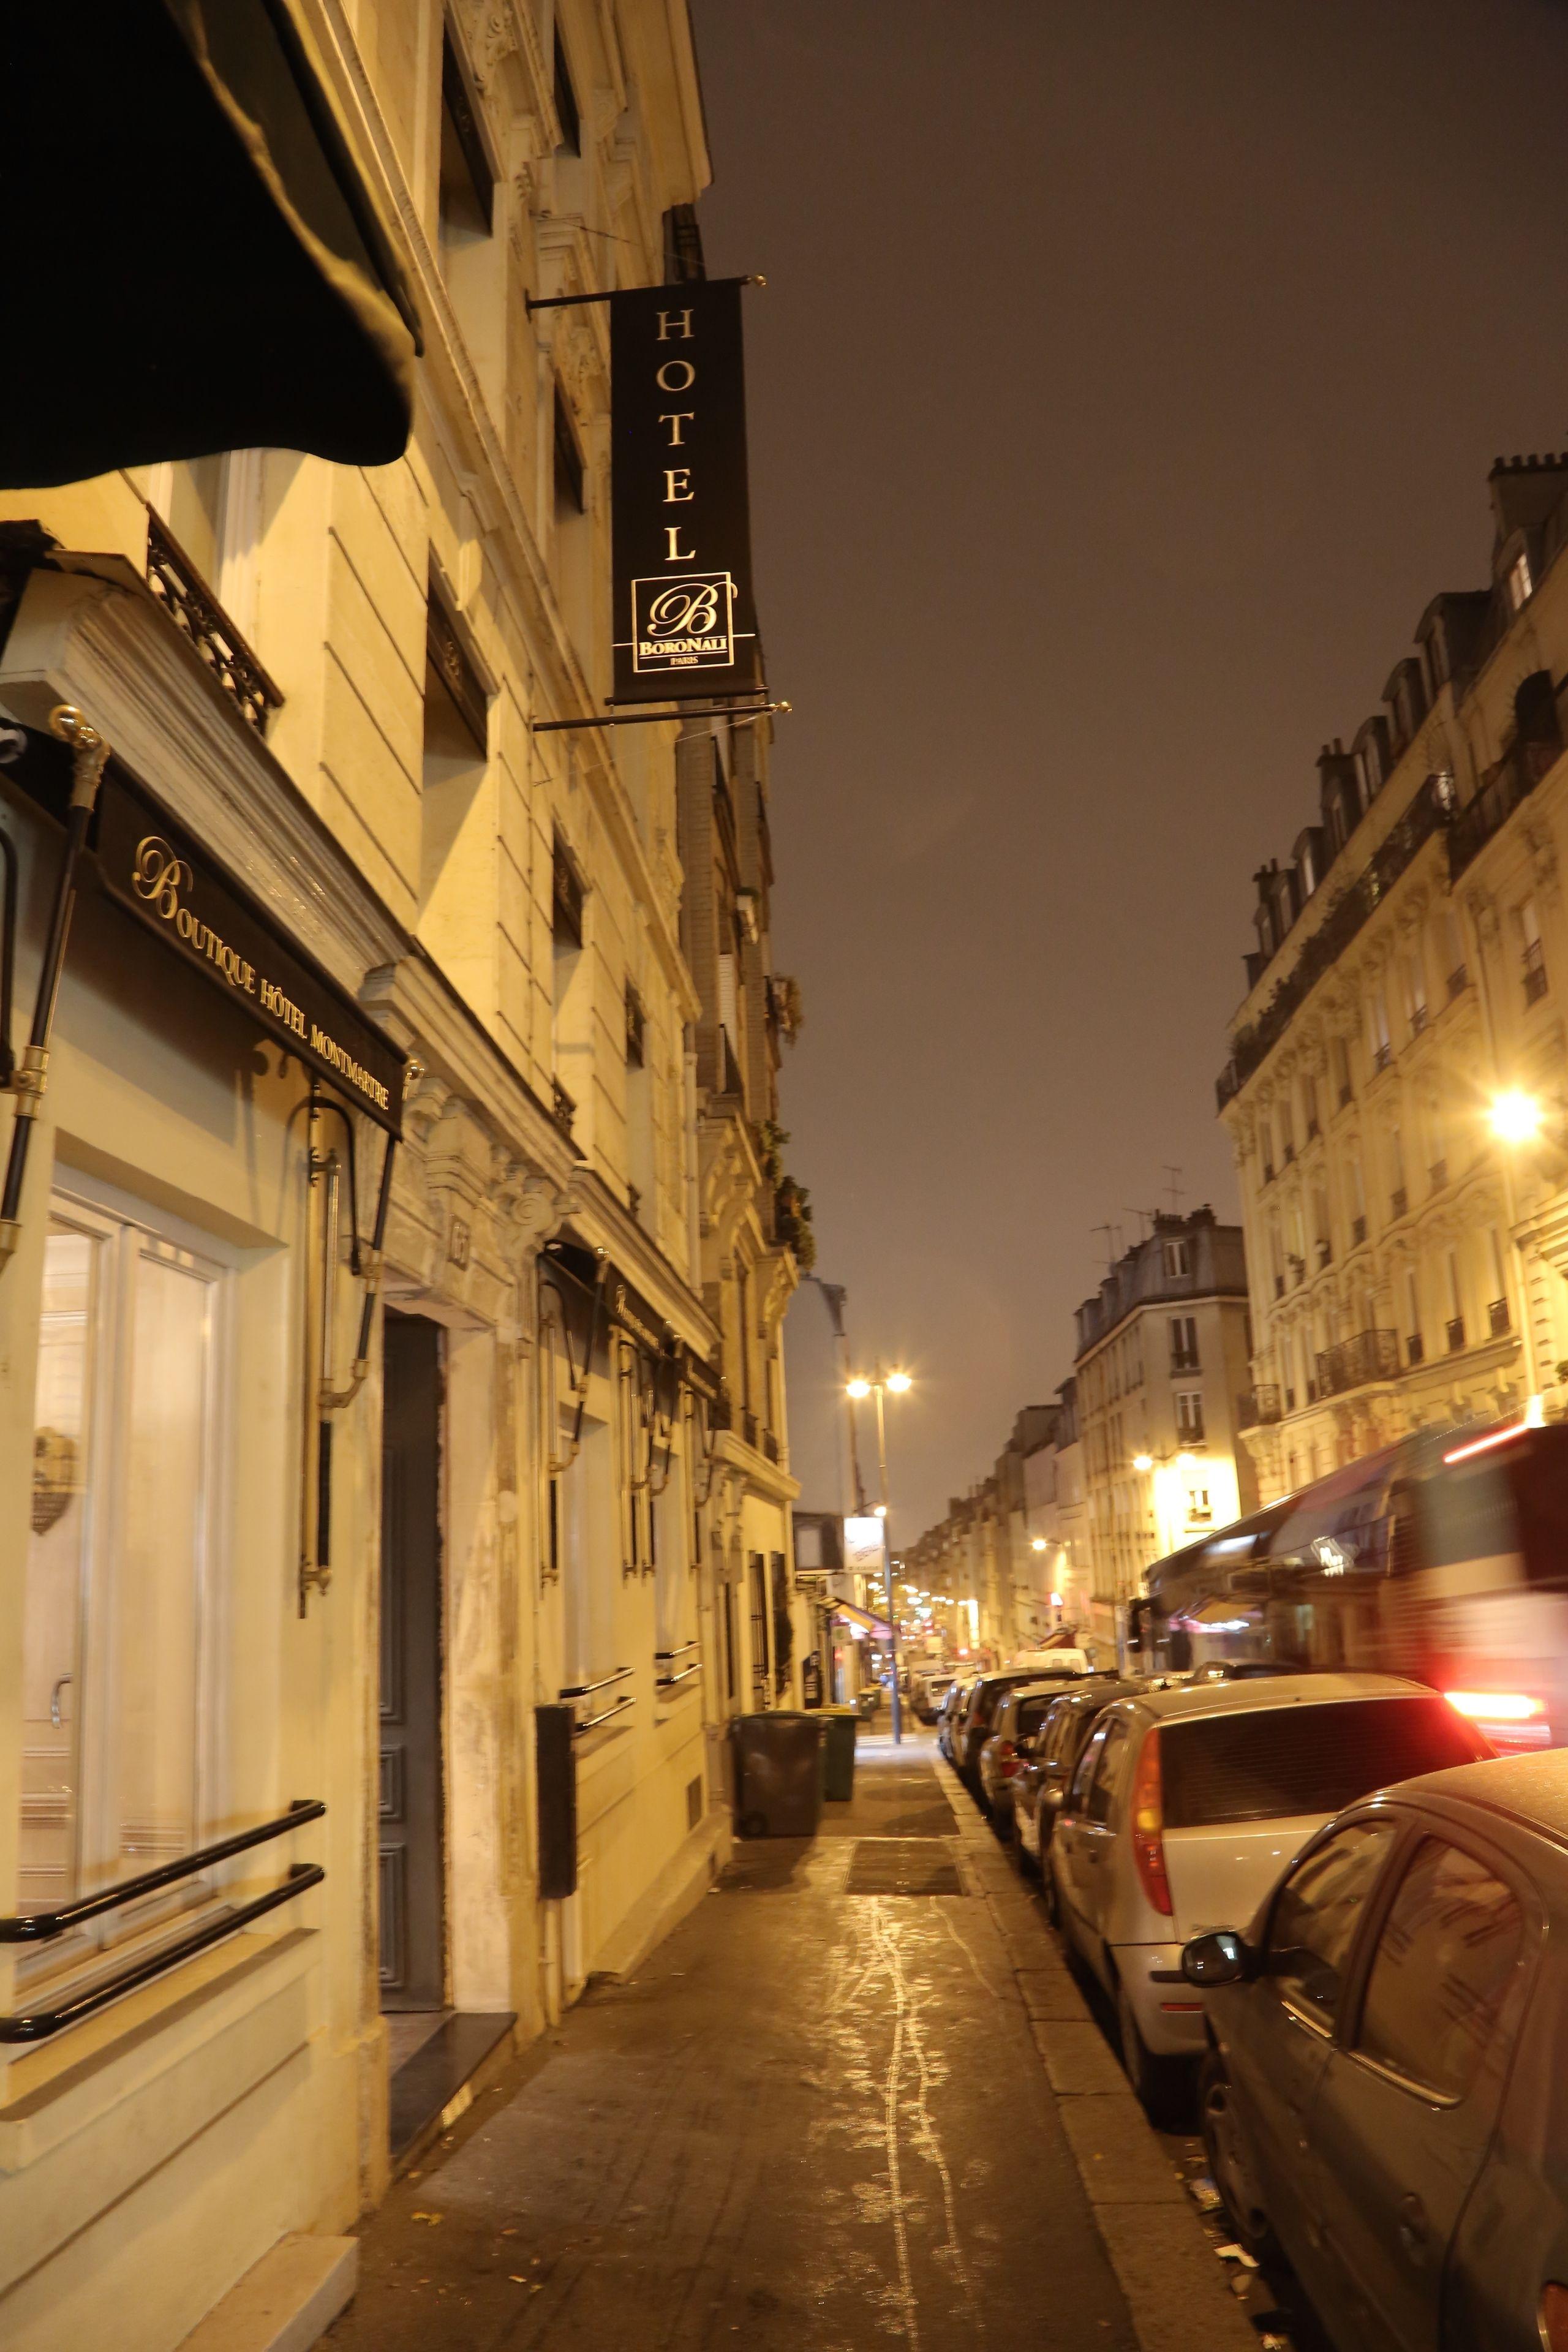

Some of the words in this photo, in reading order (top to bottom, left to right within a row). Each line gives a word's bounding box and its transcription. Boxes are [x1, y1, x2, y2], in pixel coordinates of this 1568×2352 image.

[655, 309, 696, 560] HOTEL
[670, 656, 699, 666] PARIS
[132, 836, 256, 994] BOUTIQUE
[260, 978, 307, 1039] HÔTEL
[310, 1024, 389, 1110] MONTMARTRE
